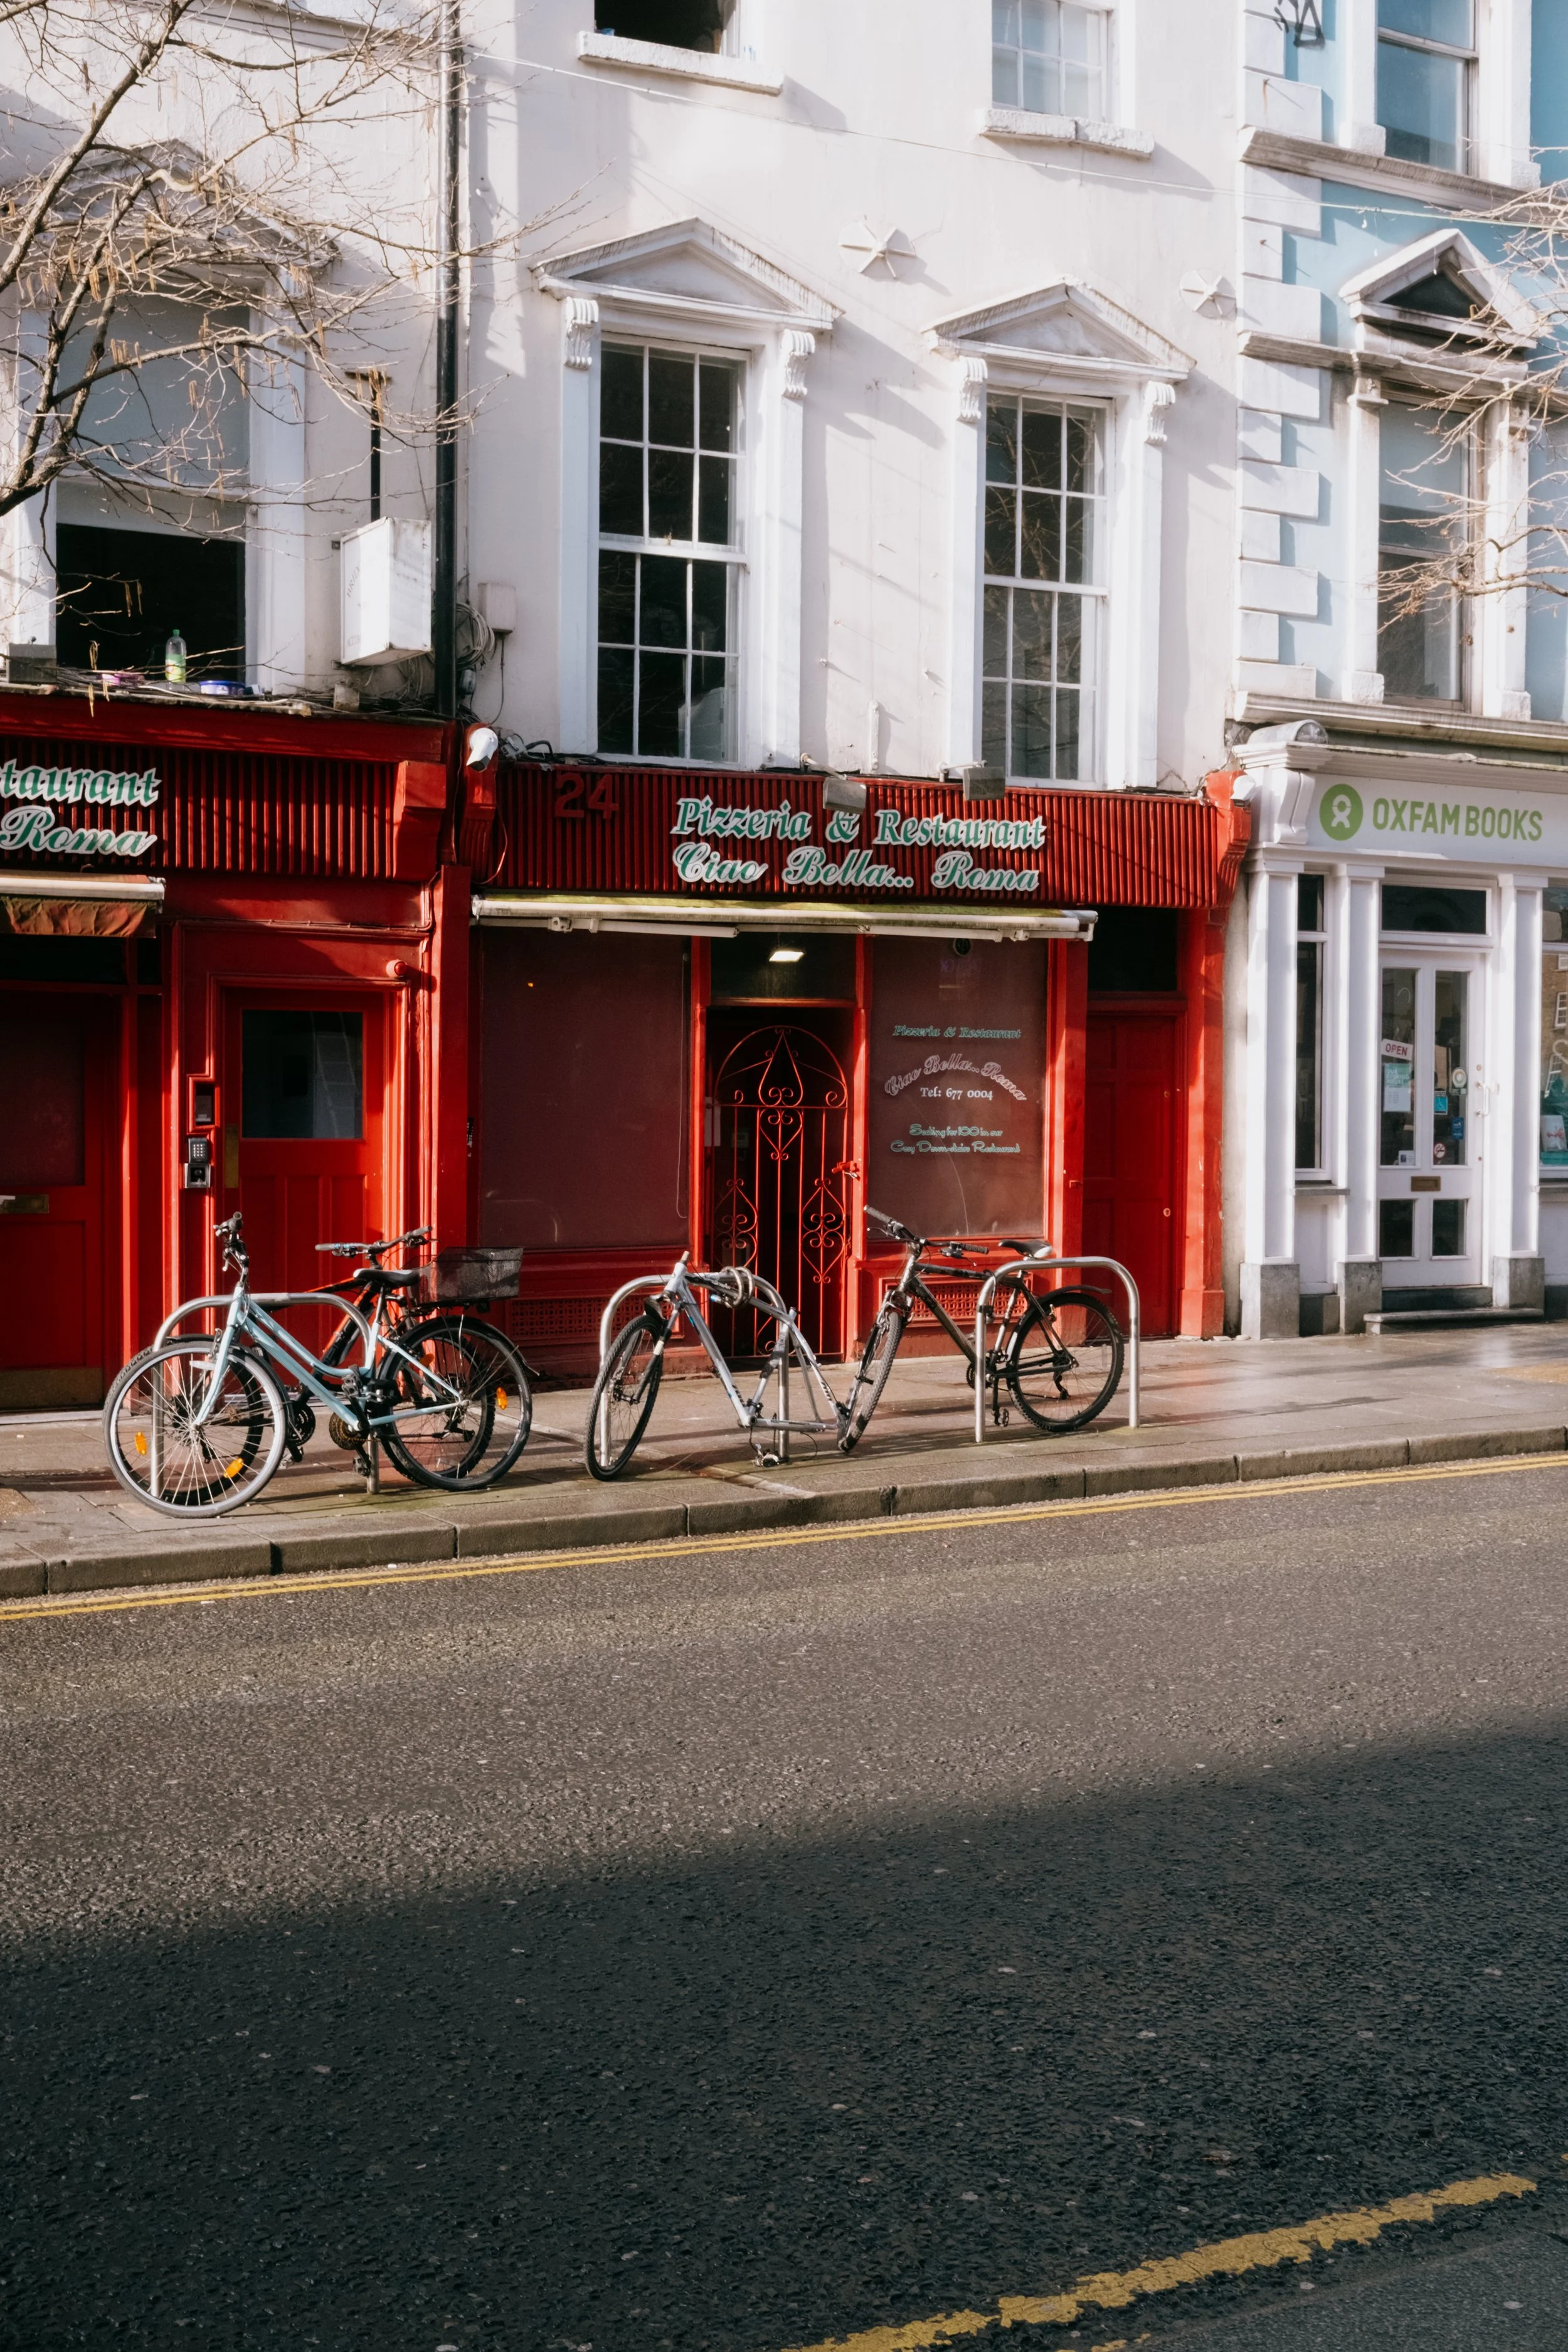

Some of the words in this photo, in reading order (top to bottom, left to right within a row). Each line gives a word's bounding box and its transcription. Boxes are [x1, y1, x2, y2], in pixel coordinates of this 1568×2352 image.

[554, 772, 619, 819] 24
[0, 805, 157, 857] Roma
[670, 795, 812, 840] Pizzeria
[825, 809, 860, 843] &
[872, 809, 1047, 850] Restaurant
[1372, 797, 1460, 835] OXFAM
[1465, 805, 1543, 842] BOOKS
[672, 842, 768, 884] Ciao
[781, 845, 913, 888] Bella...
[931, 850, 1039, 892] Roma
[892, 1025, 940, 1037] Pizzeria
[944, 1027, 956, 1038] &
[958, 1027, 1021, 1039] Restaurant
[1385, 1043, 1407, 1056] OPEN
[884, 1068, 922, 1096] Ciao
[980, 1062, 1027, 1101] Roma
[920, 1087, 941, 1097] Tel:
[946, 1088, 963, 1100] 677
[967, 1090, 993, 1101] 0004
[909, 1124, 946, 1138] Seating
[946, 1126, 958, 1136] for
[958, 1126, 980, 1136] 100
[980, 1128, 989, 1136] in
